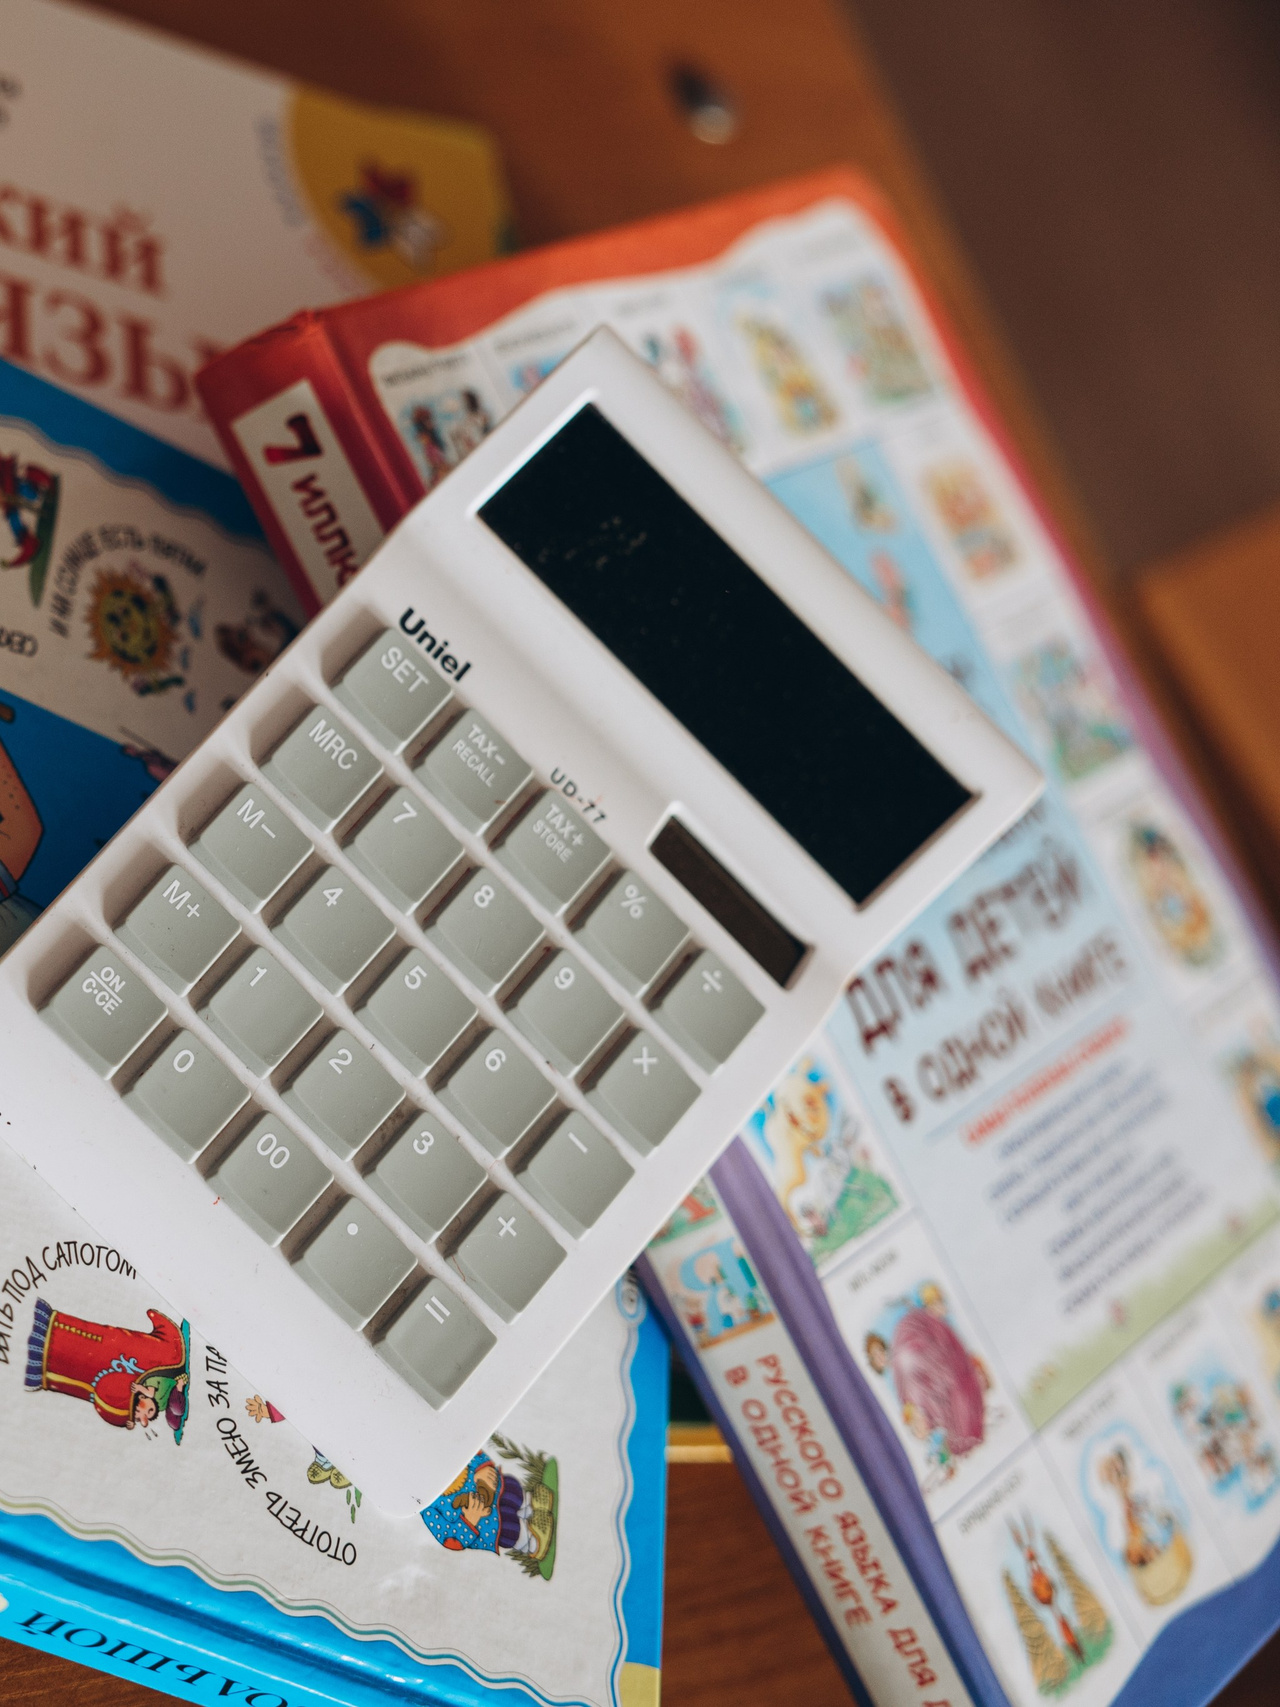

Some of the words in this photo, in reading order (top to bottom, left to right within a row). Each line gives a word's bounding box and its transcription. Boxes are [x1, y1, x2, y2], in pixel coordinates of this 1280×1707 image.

[264, 413, 322, 465] 7
[399, 607, 471, 682] Uniel
[380, 646, 429, 693] SET
[309, 719, 357, 770] MRC
[452, 739, 496, 787] RECALL
[393, 801, 418, 823] 7
[533, 819, 572, 863] STORE
[162, 879, 200, 917] M+
[323, 887, 343, 907] 4
[473, 884, 495, 908] 8
[622, 885, 647, 918] %
[100, 966, 125, 993] ON
[250, 966, 267, 987] 1
[404, 965, 427, 989] 5
[553, 967, 575, 989] 9
[845, 939, 943, 1055] ДЛЯ
[173, 1049, 194, 1072] 0
[328, 1048, 353, 1074] 2
[485, 1048, 506, 1071] 6
[256, 1133, 290, 1169] 00
[413, 1131, 434, 1155] 3
[2, 1256, 47, 1303] ПОД
[42, 1241, 136, 1280] САПОГОМ
[206, 1380, 229, 1408] ЗА
[216, 1417, 268, 1489] ЗМЕЮ
[724, 1365, 749, 1386] В
[741, 1399, 818, 1516] ОДНОЙ
[805, 1524, 872, 1628] КНИГЕ
[265, 1491, 357, 1566] ОТОГРЕТЬ
[756, 1354, 843, 1501] РУССКОГО
[834, 1511, 898, 1615] ЯЗЫКА
[888, 1627, 938, 1689] ДЛЯ
[14, 1609, 305, 1707] ОЛЬШОЙ
